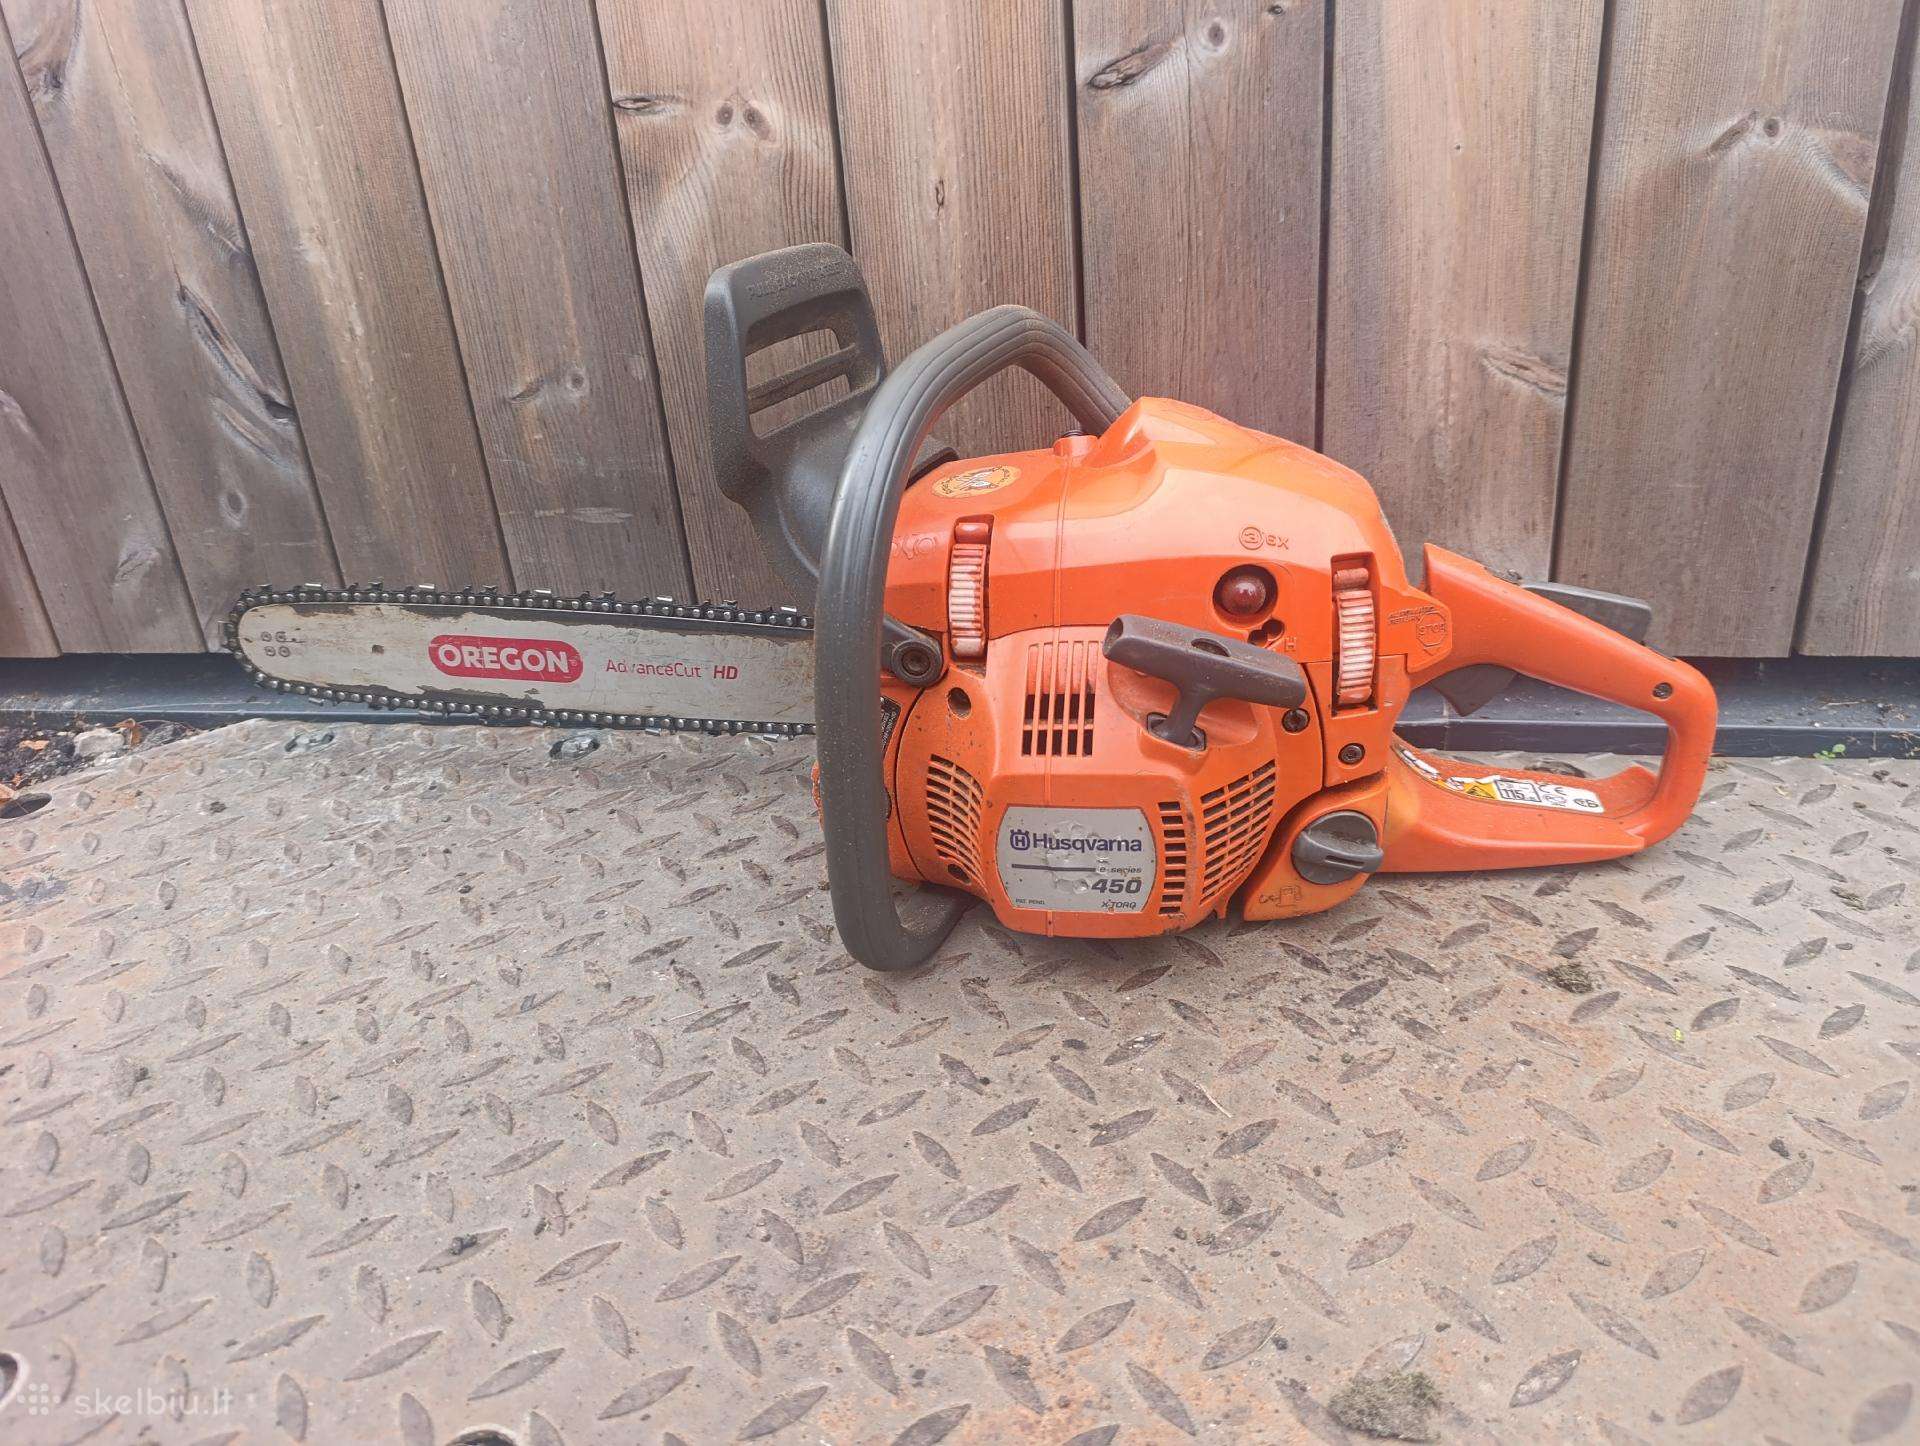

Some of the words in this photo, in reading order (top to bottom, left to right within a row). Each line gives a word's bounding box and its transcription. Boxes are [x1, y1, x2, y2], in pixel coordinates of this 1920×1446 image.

[438, 643, 570, 673] OREGON
[713, 665, 738, 680] HD
[1033, 833, 1142, 853] Husqvarna
[1091, 878, 1142, 894] 450
